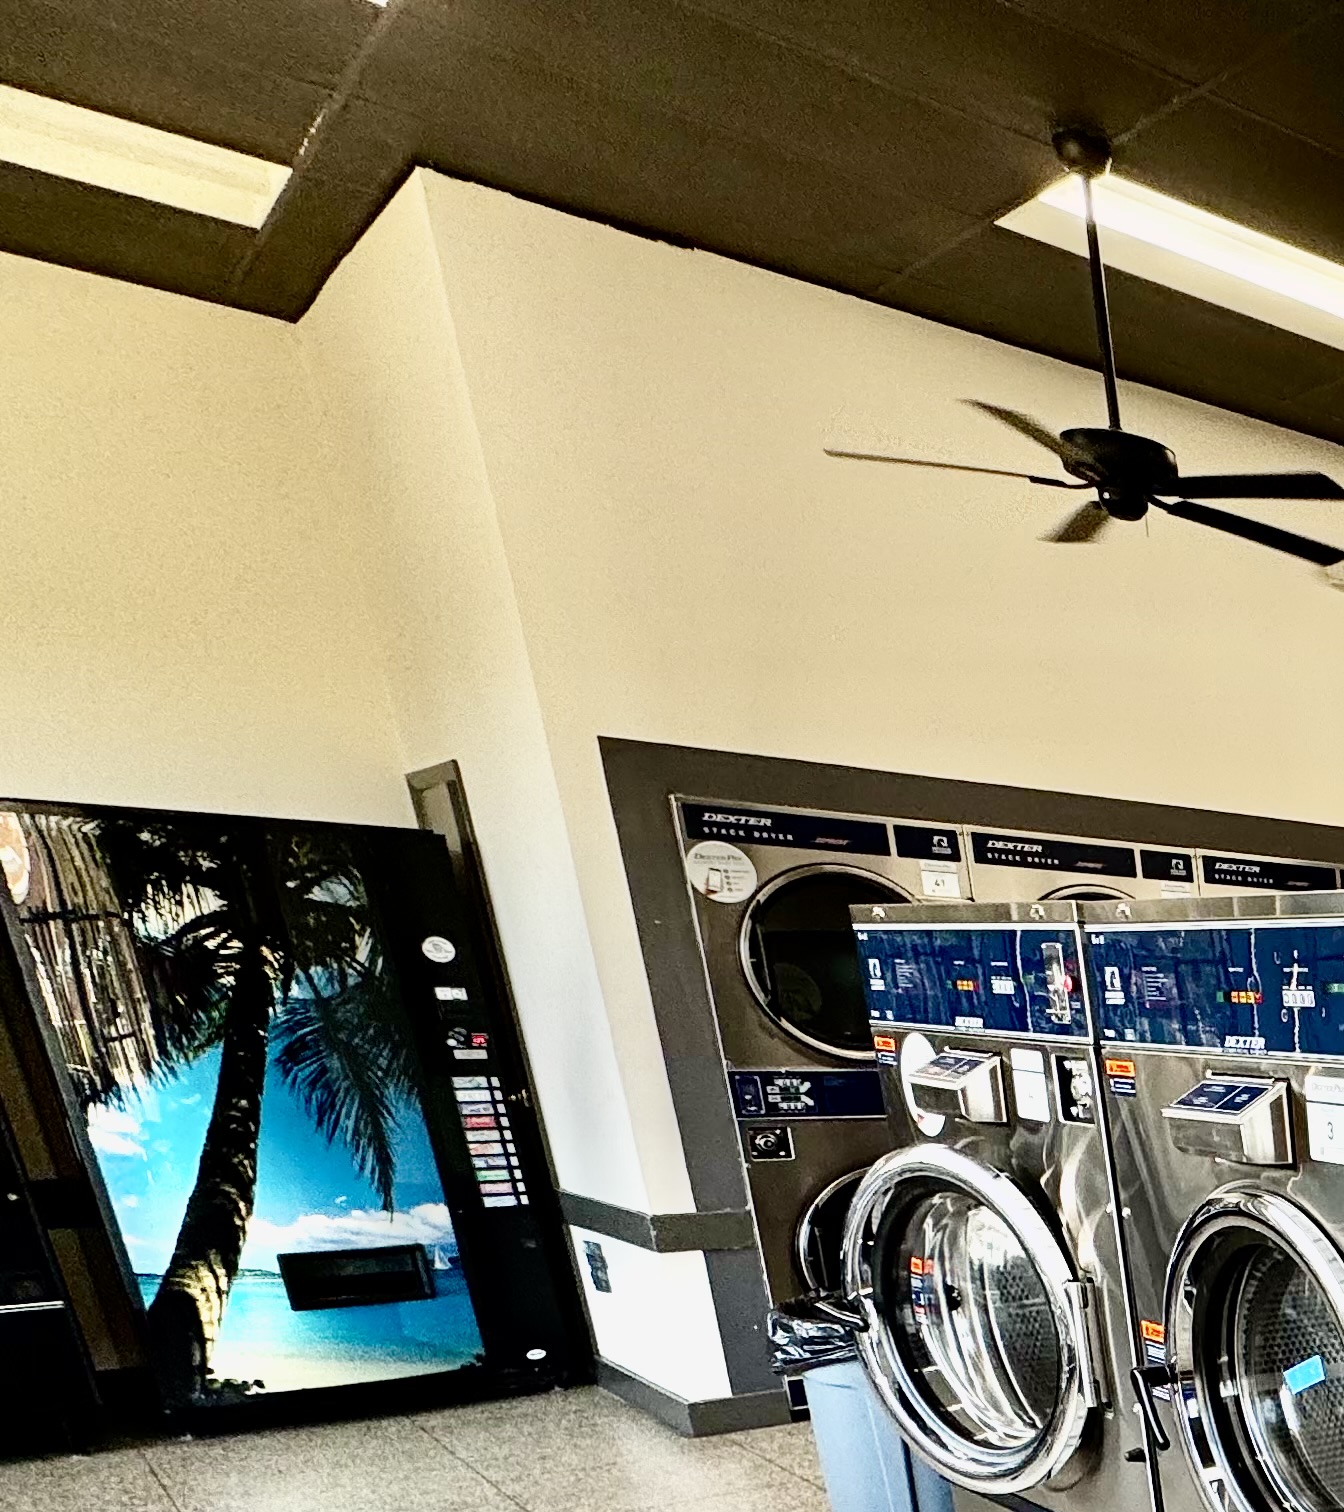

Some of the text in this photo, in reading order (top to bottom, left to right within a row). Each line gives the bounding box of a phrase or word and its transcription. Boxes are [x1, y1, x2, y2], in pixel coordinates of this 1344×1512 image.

[702, 812, 772, 827] DEXTER
[703, 826, 794, 841] STACK DRYER
[987, 839, 1042, 853] DEXTER
[1027, 856, 1060, 866] DRYER
[1214, 862, 1261, 873] DEXTER
[934, 879, 945, 888] 41
[1225, 1035, 1266, 1049] DEXTER
[1327, 1122, 1334, 1140] 3
